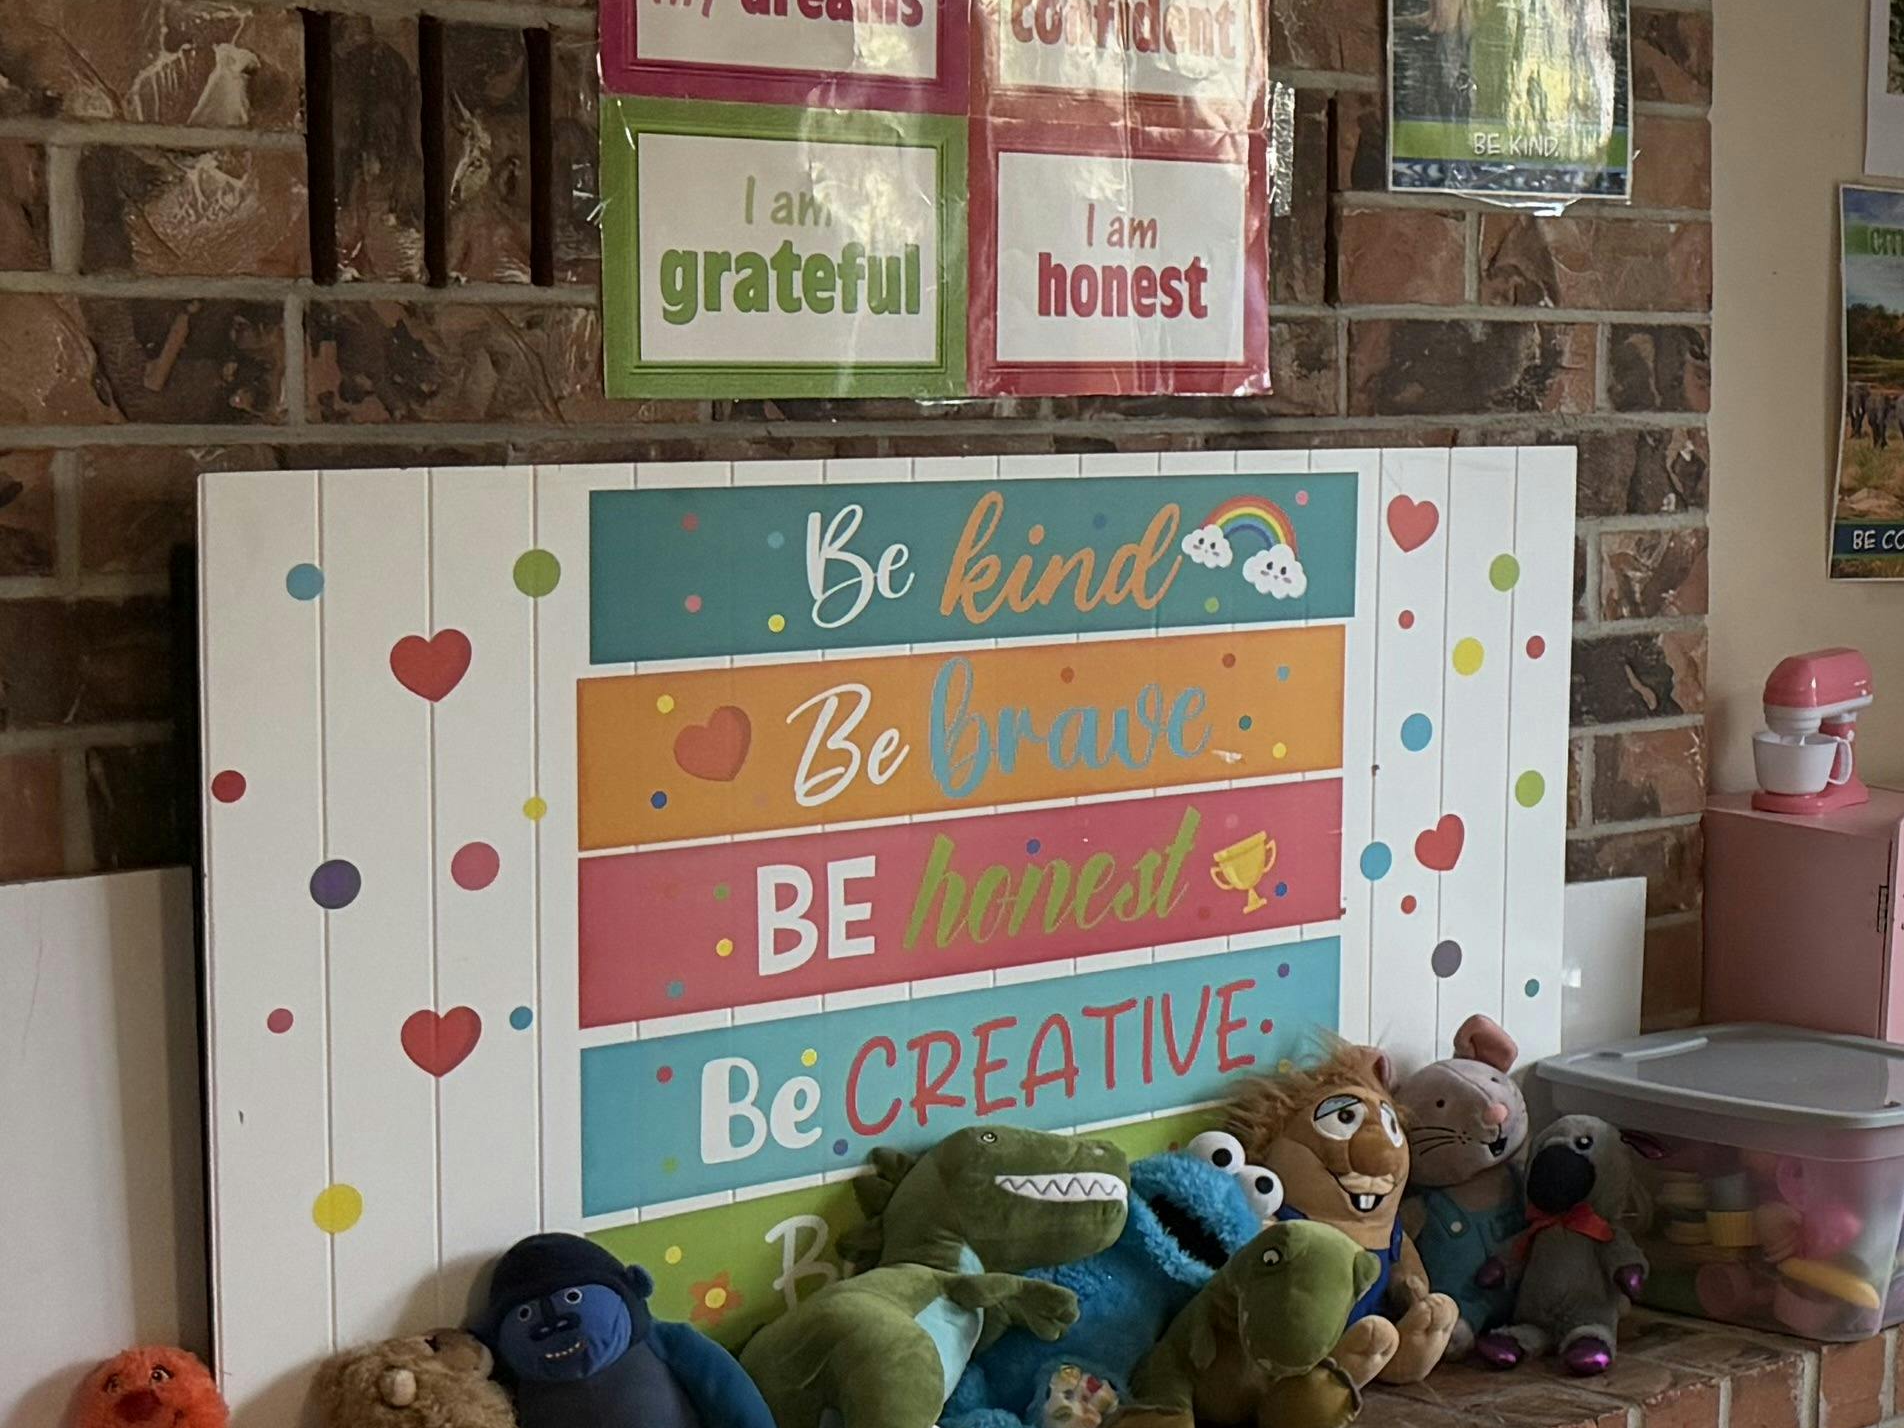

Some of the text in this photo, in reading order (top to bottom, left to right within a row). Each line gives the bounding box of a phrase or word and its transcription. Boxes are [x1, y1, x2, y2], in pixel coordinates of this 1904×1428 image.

[1472, 131, 1500, 155] BE
[745, 174, 833, 228] I am
[1086, 202, 1158, 250] I am
[659, 239, 921, 326] grateful
[1037, 251, 1208, 320] honest
[805, 489, 1183, 630] Be kind
[1852, 529, 1876, 550] BE
[785, 654, 1217, 809] Be brave
[756, 804, 1201, 976] BE honest
[699, 1055, 823, 1166] Be
